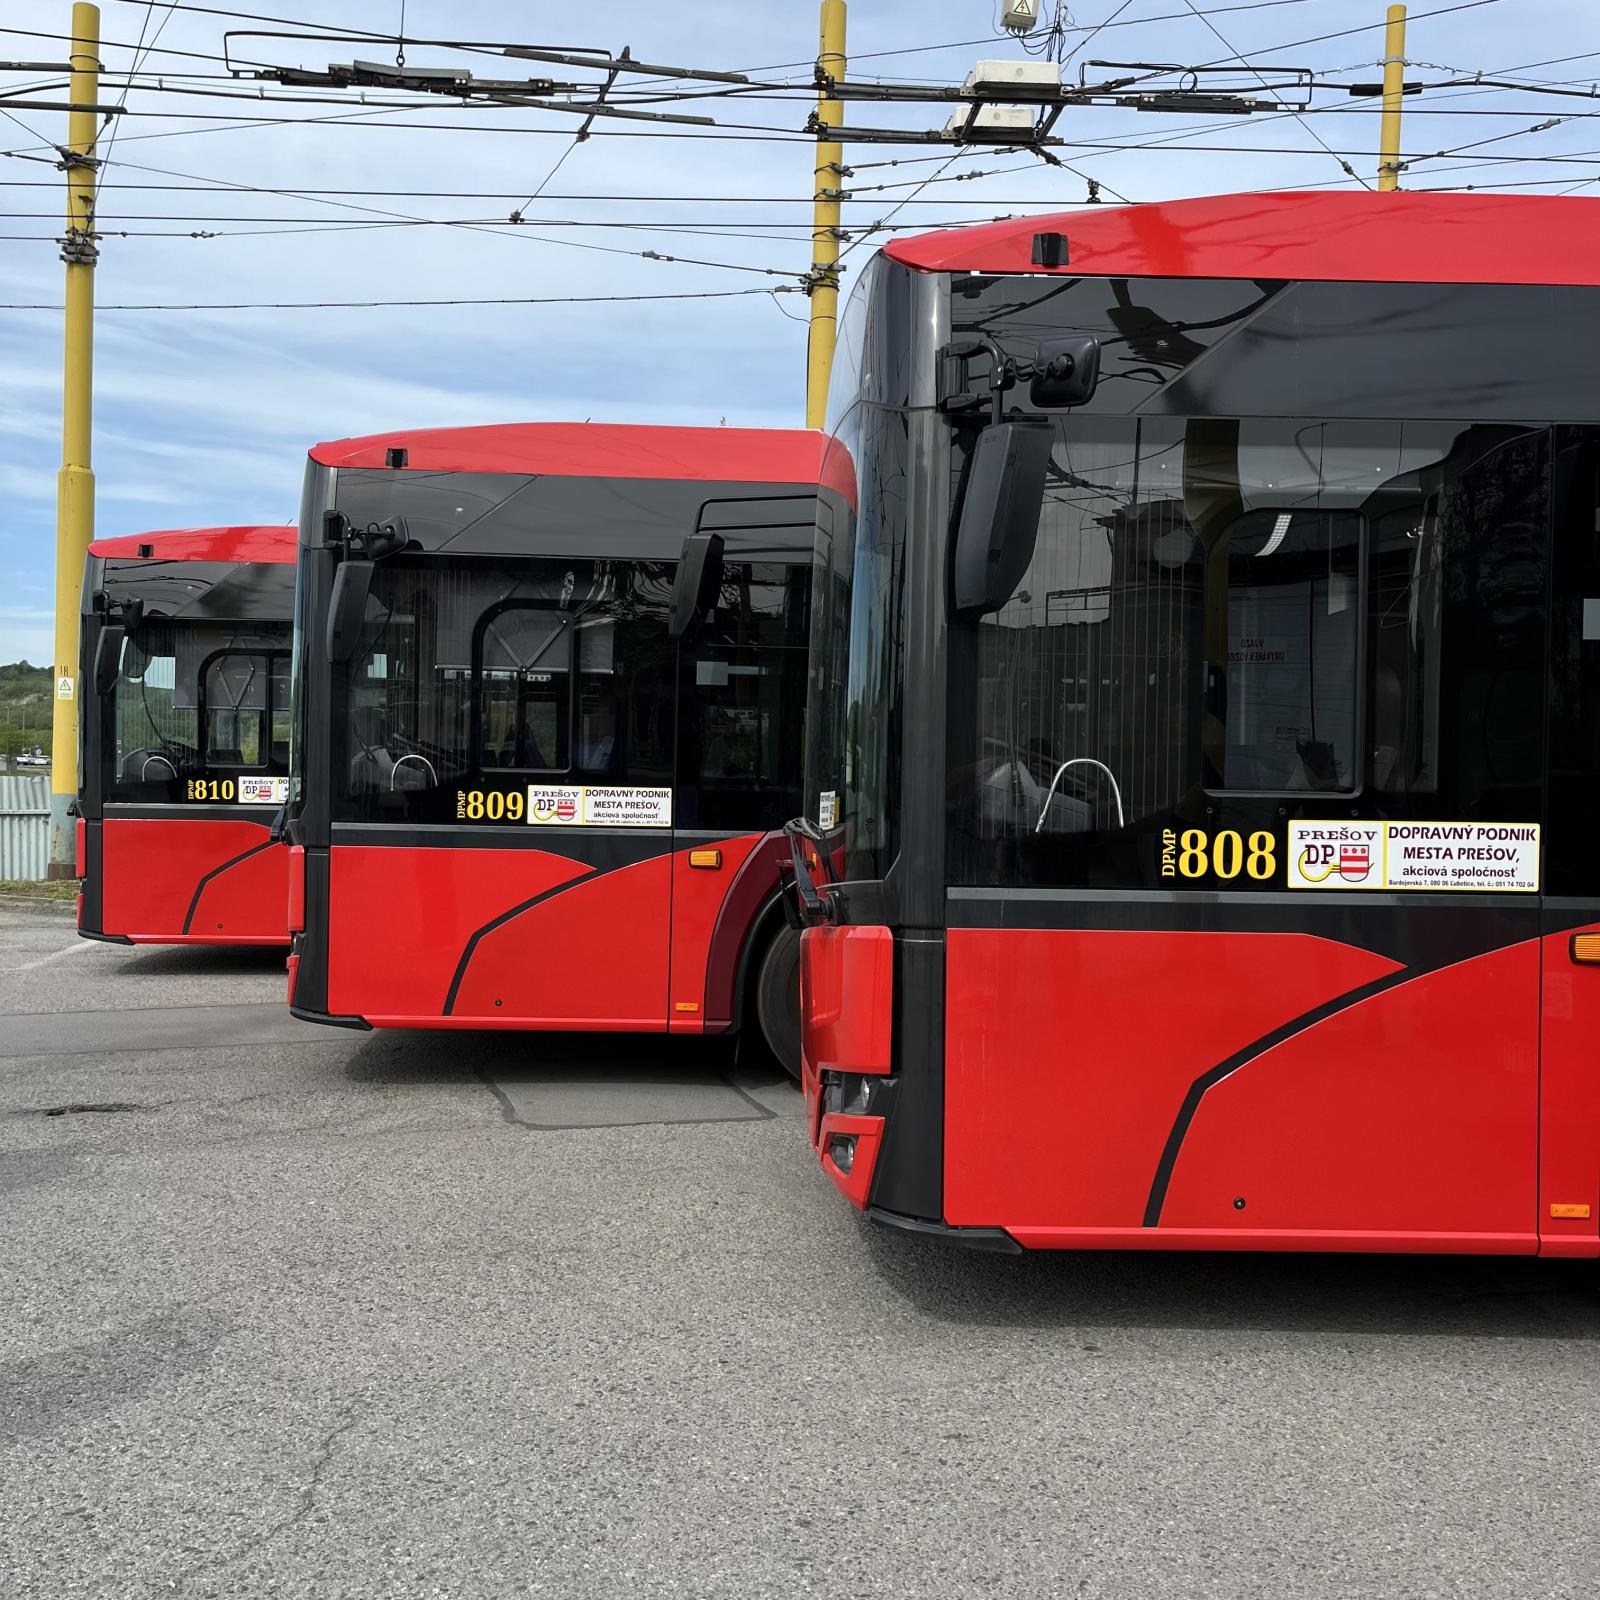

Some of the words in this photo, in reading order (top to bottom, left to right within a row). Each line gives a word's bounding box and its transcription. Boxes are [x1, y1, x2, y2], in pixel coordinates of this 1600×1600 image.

[187, 780, 195, 799] DPMP
[195, 779, 235, 800] 810
[245, 786, 258, 794] DP
[533, 789, 580, 798] PREŠOV
[585, 788, 635, 798] DOPRAVNÝ
[636, 790, 670, 798] PODNIK
[457, 790, 466, 819] DPMP
[467, 790, 524, 820] 809
[537, 799, 555, 811] DP
[594, 801, 623, 809] MESTA
[1297, 826, 1378, 841] PREŠOV
[1388, 824, 1473, 840] DOPRAVNÝ
[1476, 828, 1537, 841] PODNIK
[1162, 828, 1177, 878] DPMP
[1178, 829, 1277, 880] 808
[1304, 844, 1335, 865] DP
[1403, 847, 1454, 860] MESTA
[1457, 845, 1520, 863] PREŠOV,
[1402, 865, 1448, 877] akciová
[1451, 866, 1518, 880] spoločnosť
[1388, 879, 1423, 887] Bardejovská
